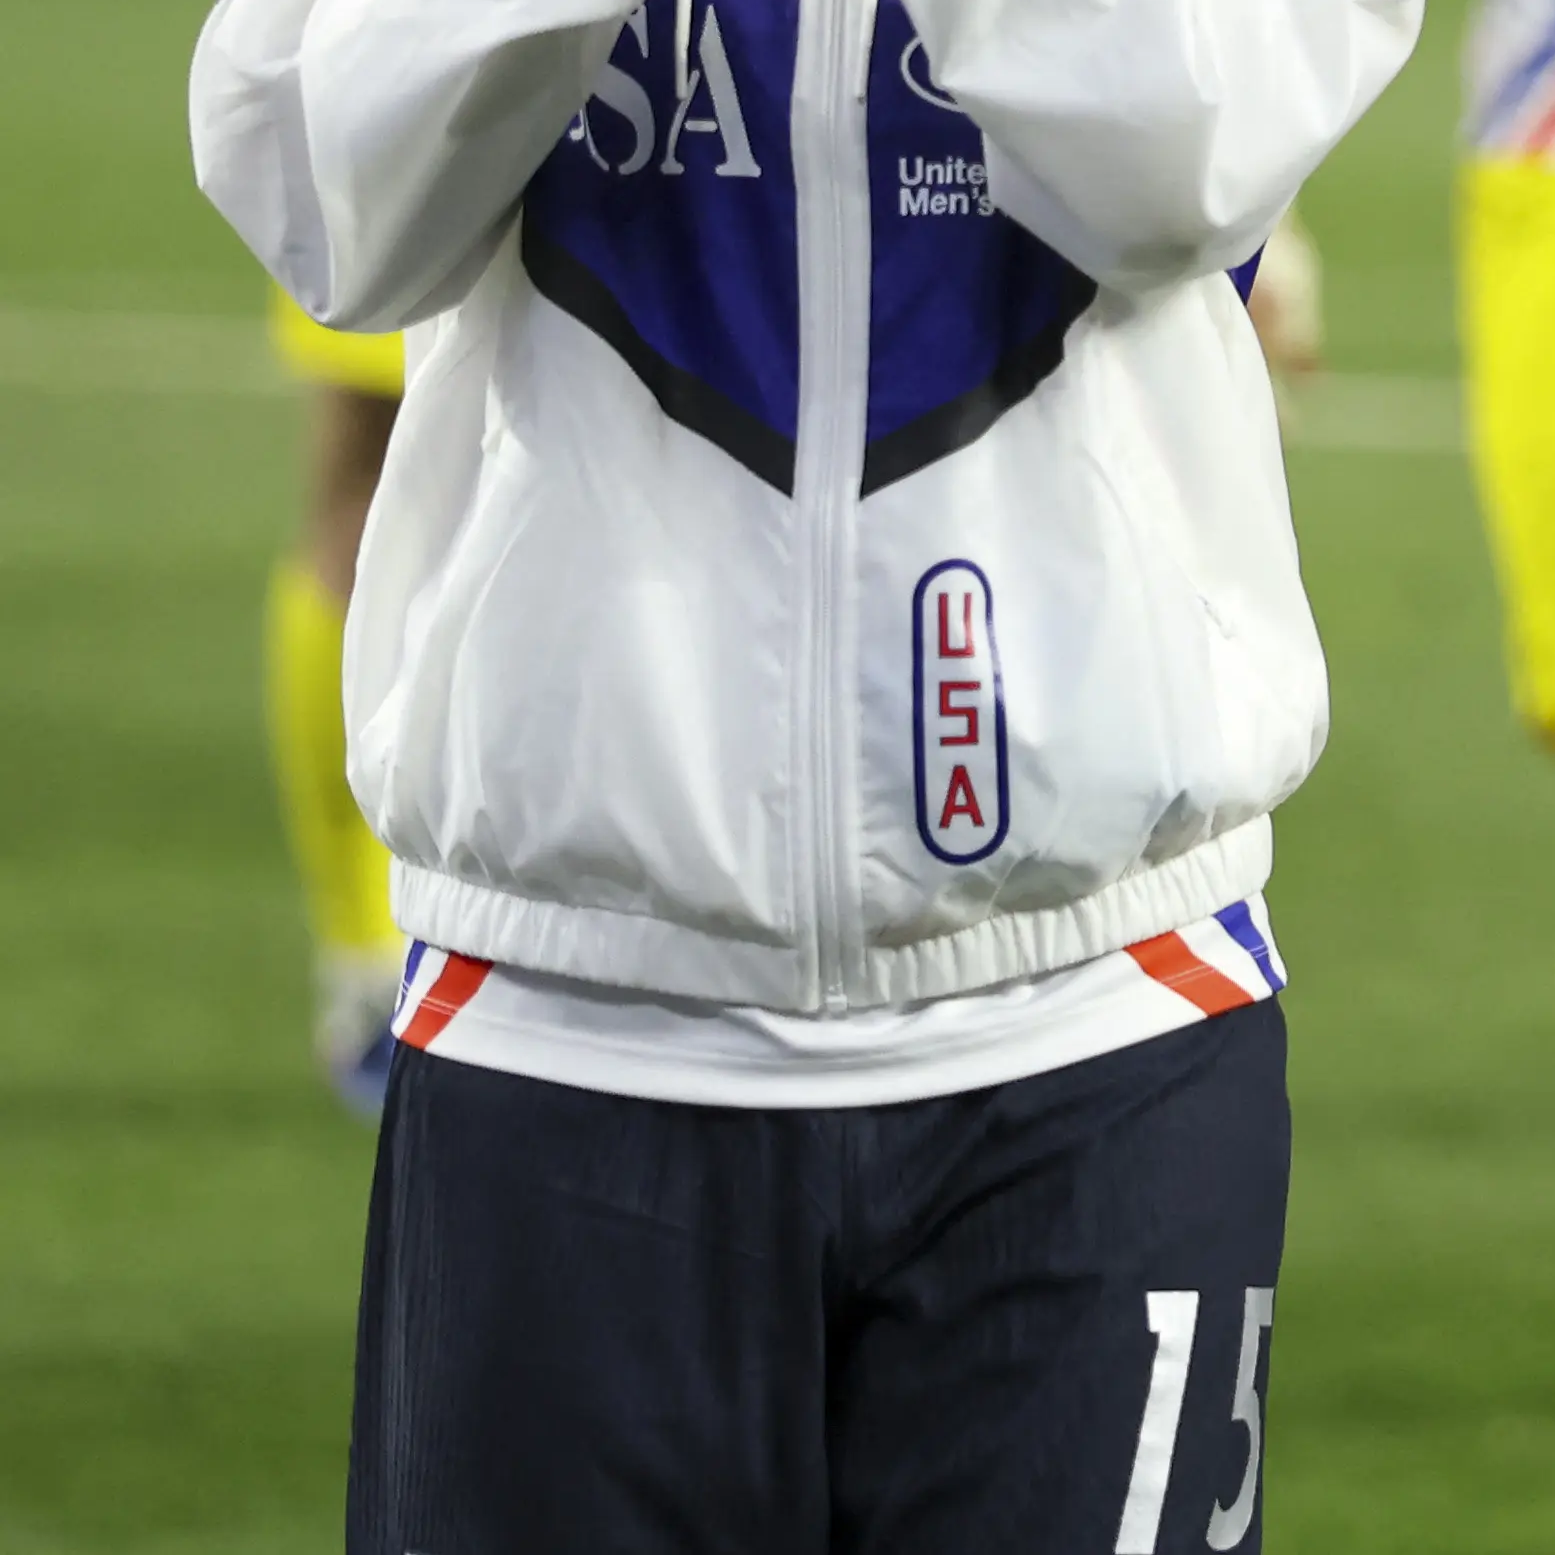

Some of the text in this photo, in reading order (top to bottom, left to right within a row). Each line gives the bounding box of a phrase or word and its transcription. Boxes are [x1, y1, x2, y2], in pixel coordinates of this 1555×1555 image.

[570, 3, 762, 178] SA
[898, 156, 987, 186] Unite
[899, 187, 995, 217] Men's
[937, 592, 985, 830] USA
[1114, 1286, 1274, 1555] 15
